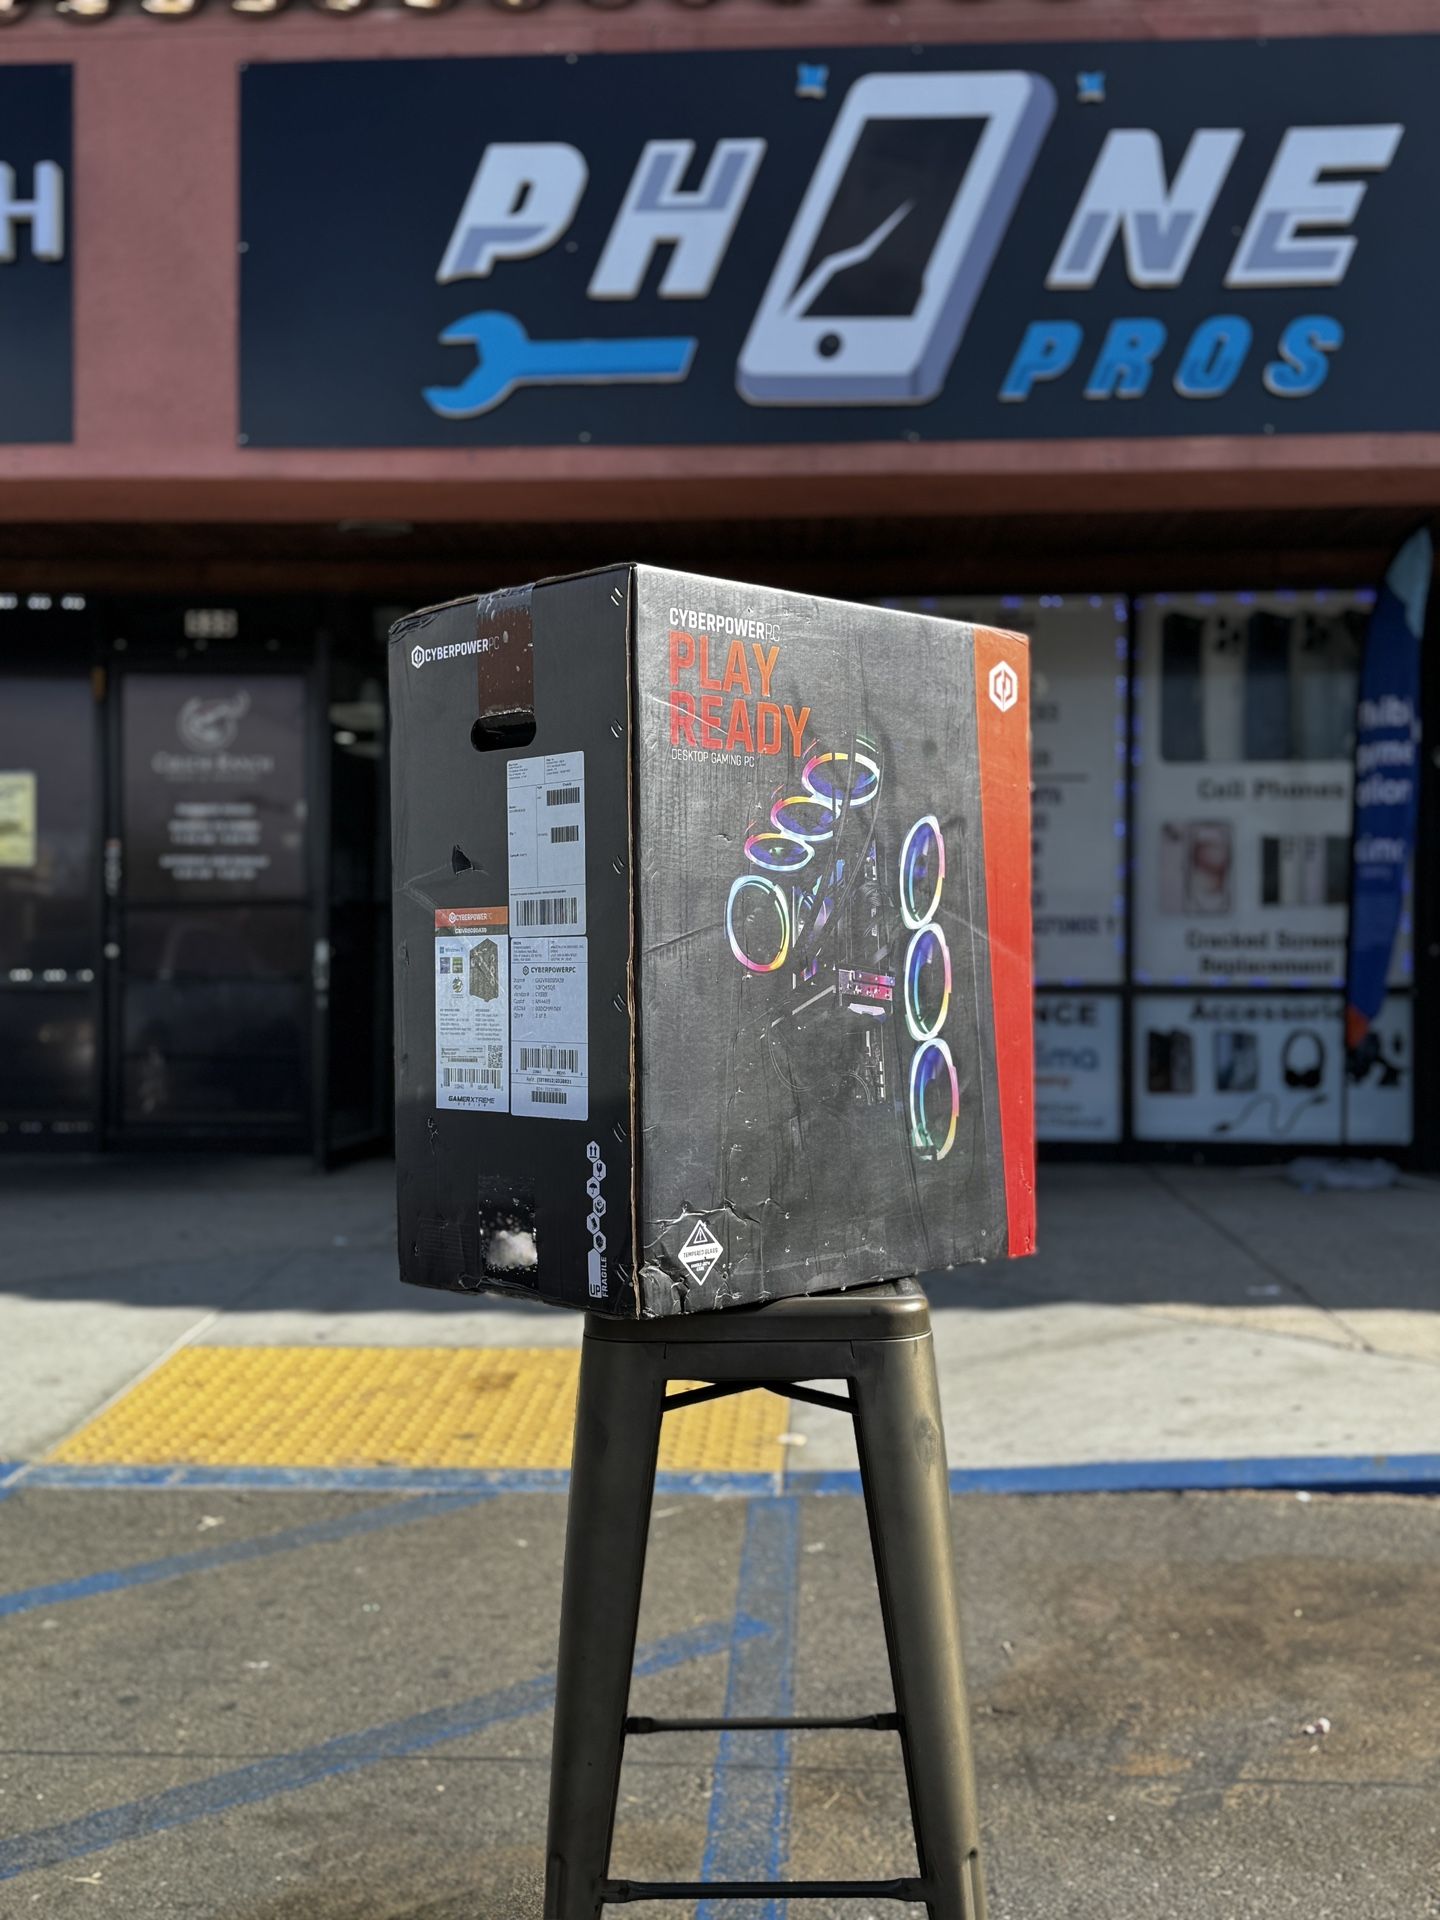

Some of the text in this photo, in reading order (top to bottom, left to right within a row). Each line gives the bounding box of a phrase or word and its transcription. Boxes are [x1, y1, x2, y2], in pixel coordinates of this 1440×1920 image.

[1000, 314, 1344, 402] PROS
[670, 607, 780, 641] CYBERPOWERPC
[424, 635, 500, 662] CYBERPOWERPC
[669, 630, 780, 697] PLAY
[669, 690, 811, 758] READY
[671, 749, 755, 768] DESKTOP GAMING PC
[1196, 778, 1245, 798] Cell
[1253, 779, 1345, 799] Phones
[1186, 930, 1271, 949] Cracked
[1200, 956, 1333, 977] Replacement
[590, 1283, 601, 1296] UP
[600, 1256, 609, 1298] FRAGILE
